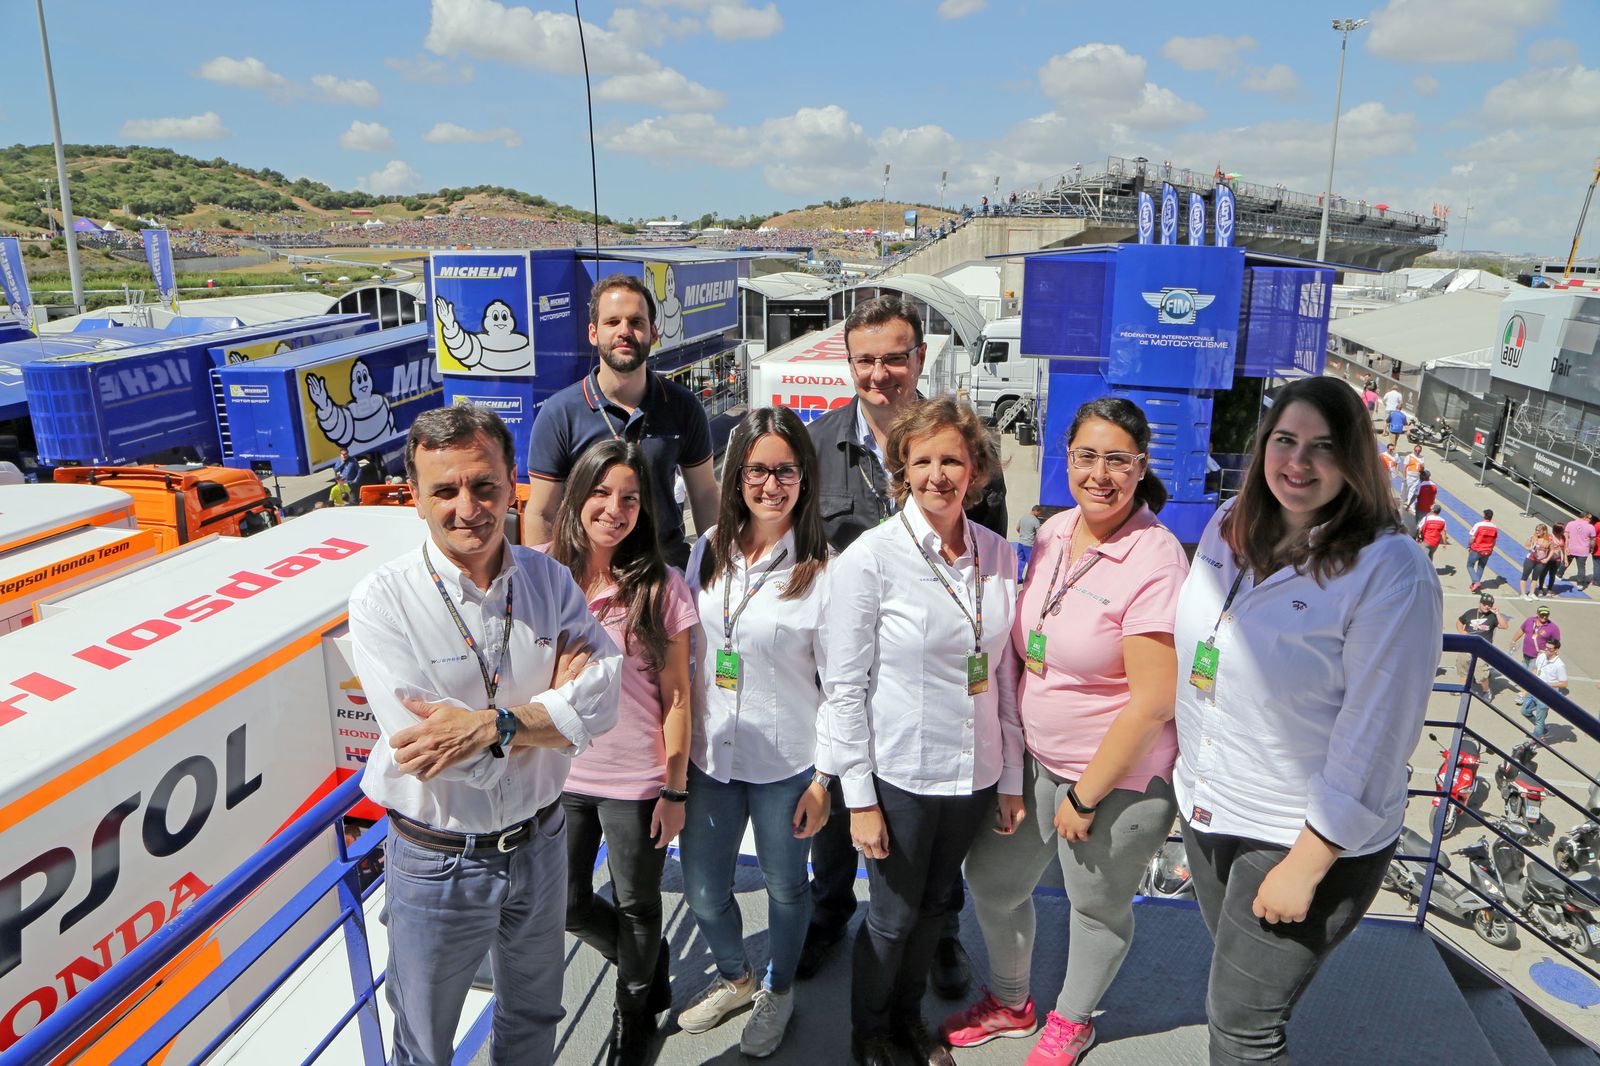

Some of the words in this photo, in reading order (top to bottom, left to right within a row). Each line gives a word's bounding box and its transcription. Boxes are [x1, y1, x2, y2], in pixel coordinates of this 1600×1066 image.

[440, 267, 518, 277] MICHELIN
[684, 280, 735, 307] MICHELIN
[1166, 299, 1190, 314] FIM
[1161, 334, 1215, 342] INTERNATIONALE
[1151, 339, 1229, 349] MOTOCYCLISME
[781, 375, 847, 386] HONDA
[474, 400, 520, 408] MICHELIN
[0, 570, 48, 594] Repsol
[51, 553, 95, 576] Honda
[97, 541, 130, 559] Team
[72, 537, 370, 670] Repsol
